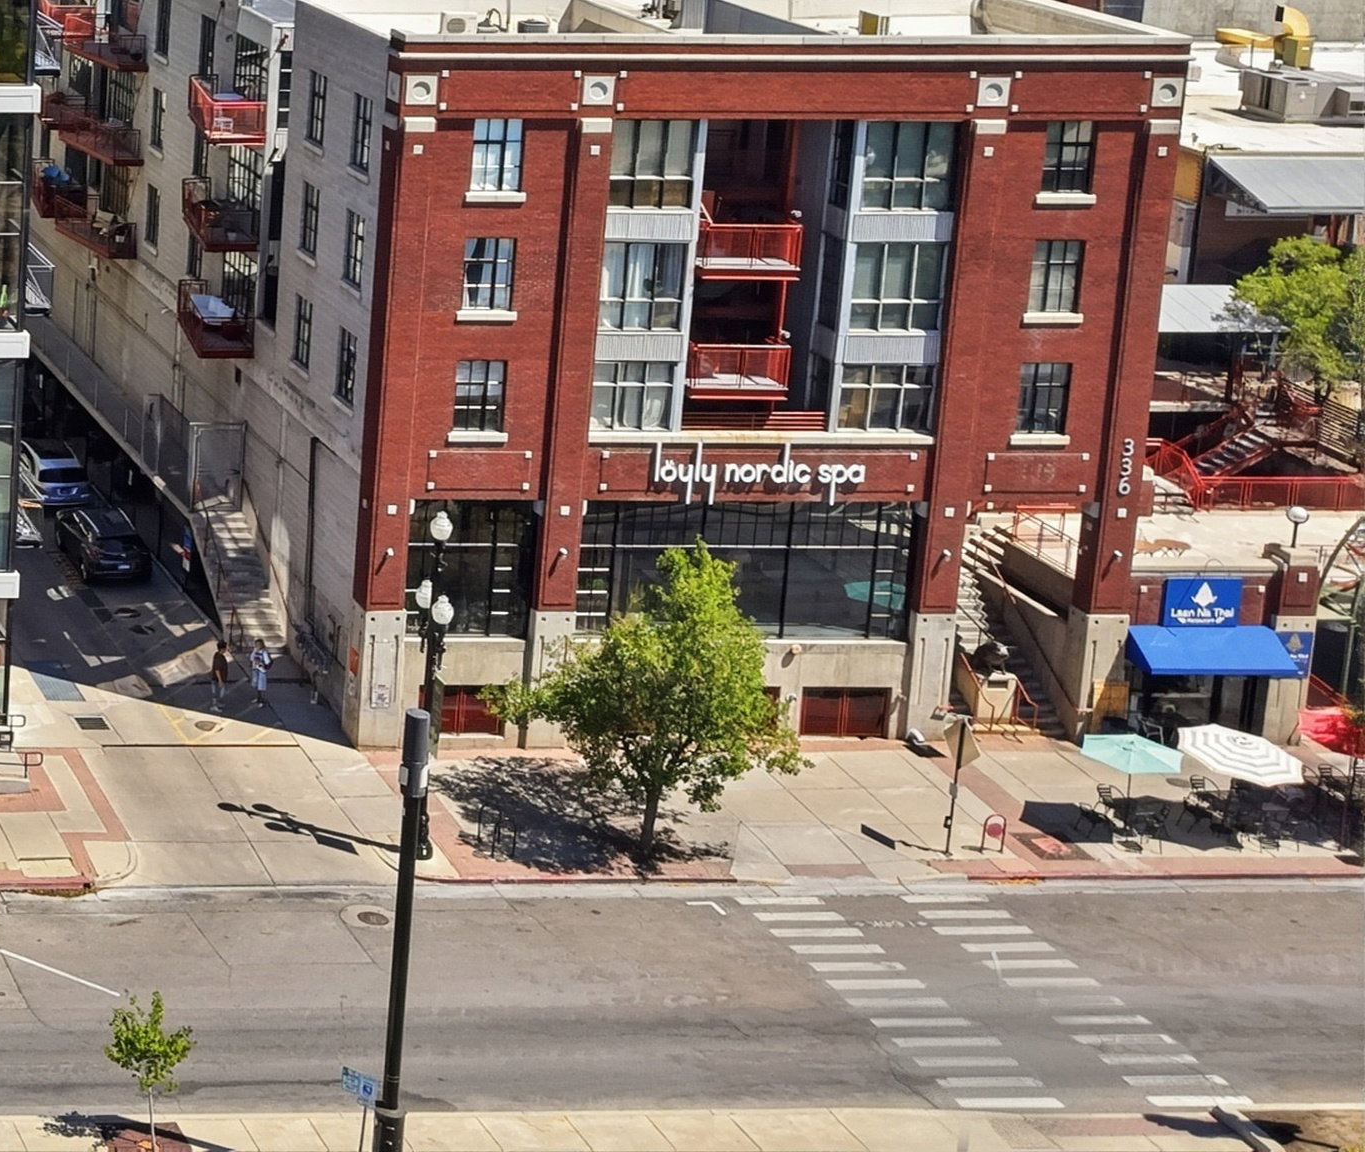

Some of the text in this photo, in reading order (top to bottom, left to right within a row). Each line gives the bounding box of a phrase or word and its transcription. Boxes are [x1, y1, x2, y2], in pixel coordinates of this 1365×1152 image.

[654, 441, 866, 506] löyly nordic spa
[1118, 437, 1135, 495] 336
[1197, 607, 1212, 618] Na
[1212, 607, 1235, 618] Thai
